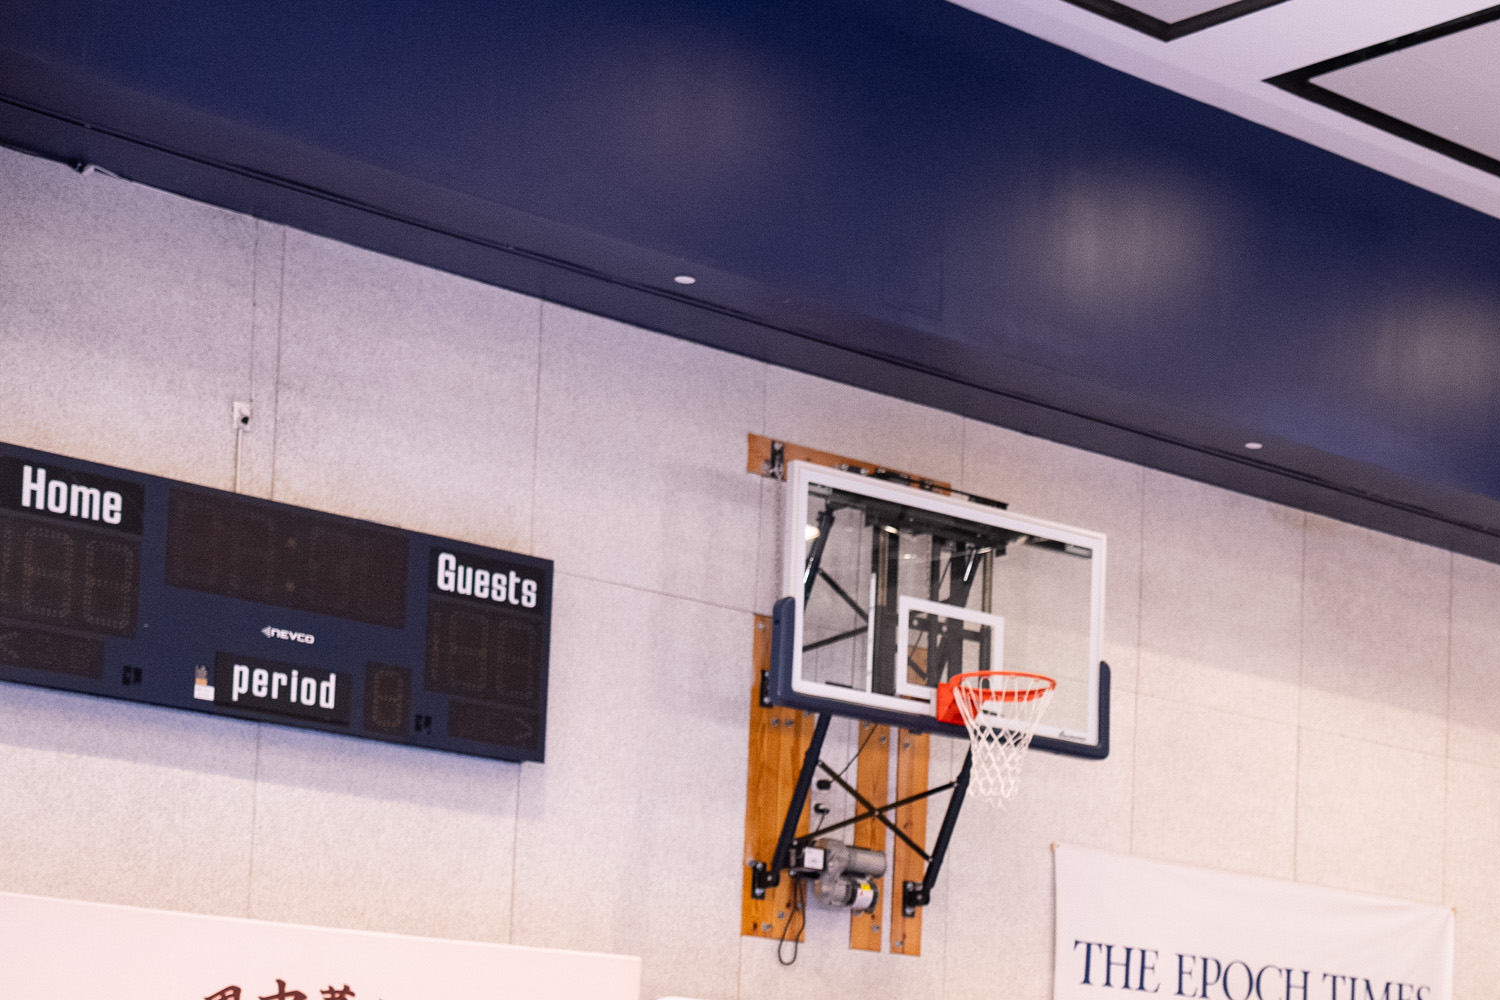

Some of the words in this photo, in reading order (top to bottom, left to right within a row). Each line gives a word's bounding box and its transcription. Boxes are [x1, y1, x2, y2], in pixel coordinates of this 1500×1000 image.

[21, 465, 123, 525] Home
[436, 553, 538, 608] Guests
[231, 663, 338, 709] period
[1073, 939, 1161, 994] THE
